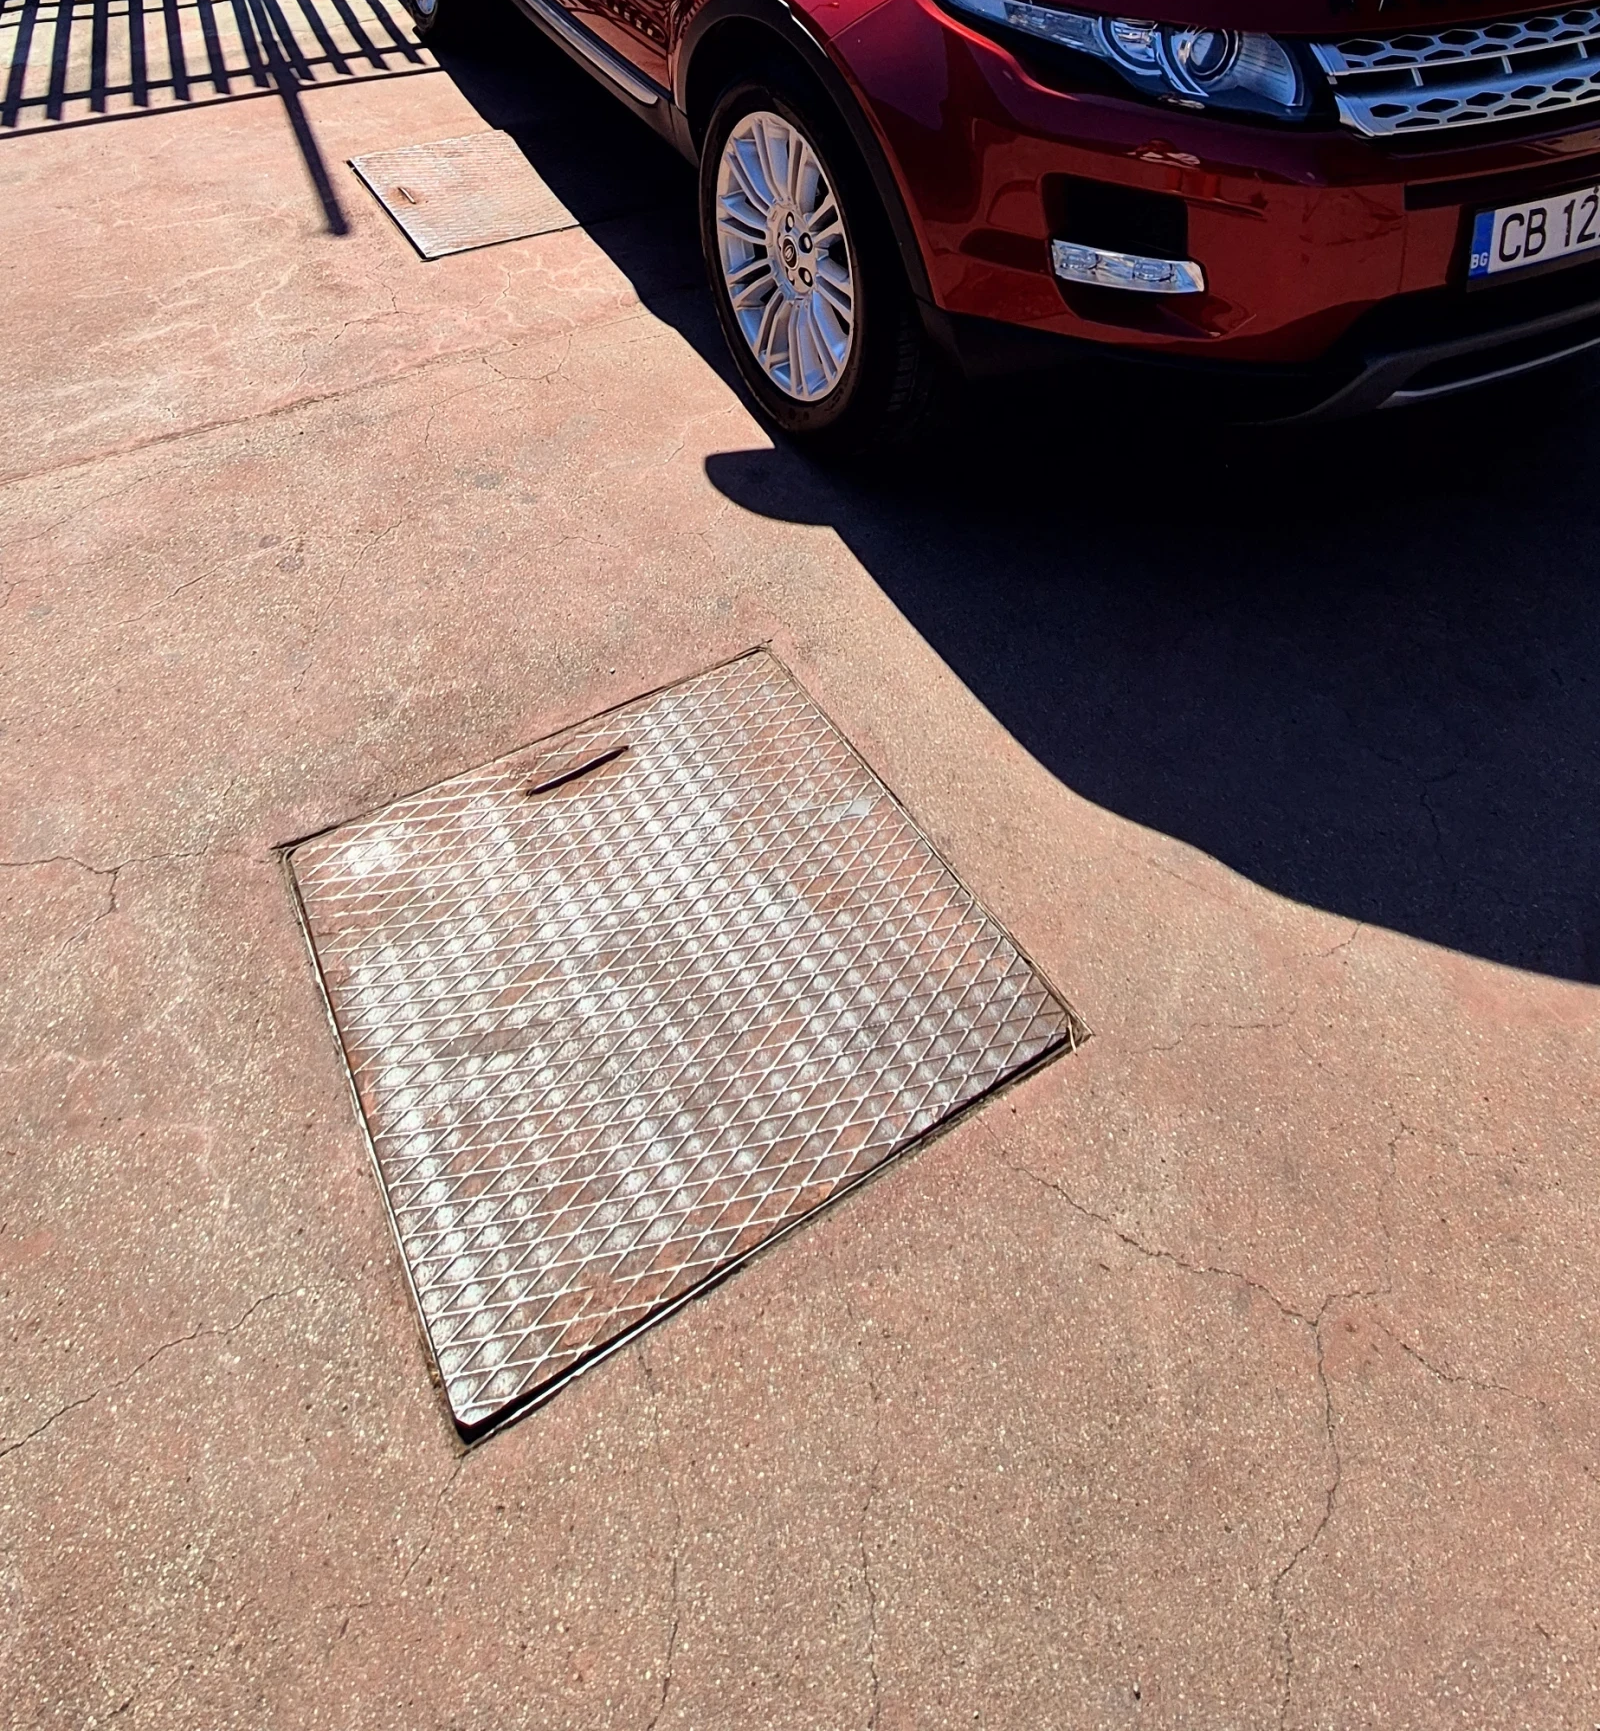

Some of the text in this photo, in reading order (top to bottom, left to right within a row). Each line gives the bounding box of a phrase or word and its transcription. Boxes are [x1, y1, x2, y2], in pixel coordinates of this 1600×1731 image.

[1499, 194, 1600, 262] CB 12
[1471, 252, 1489, 269] BG
